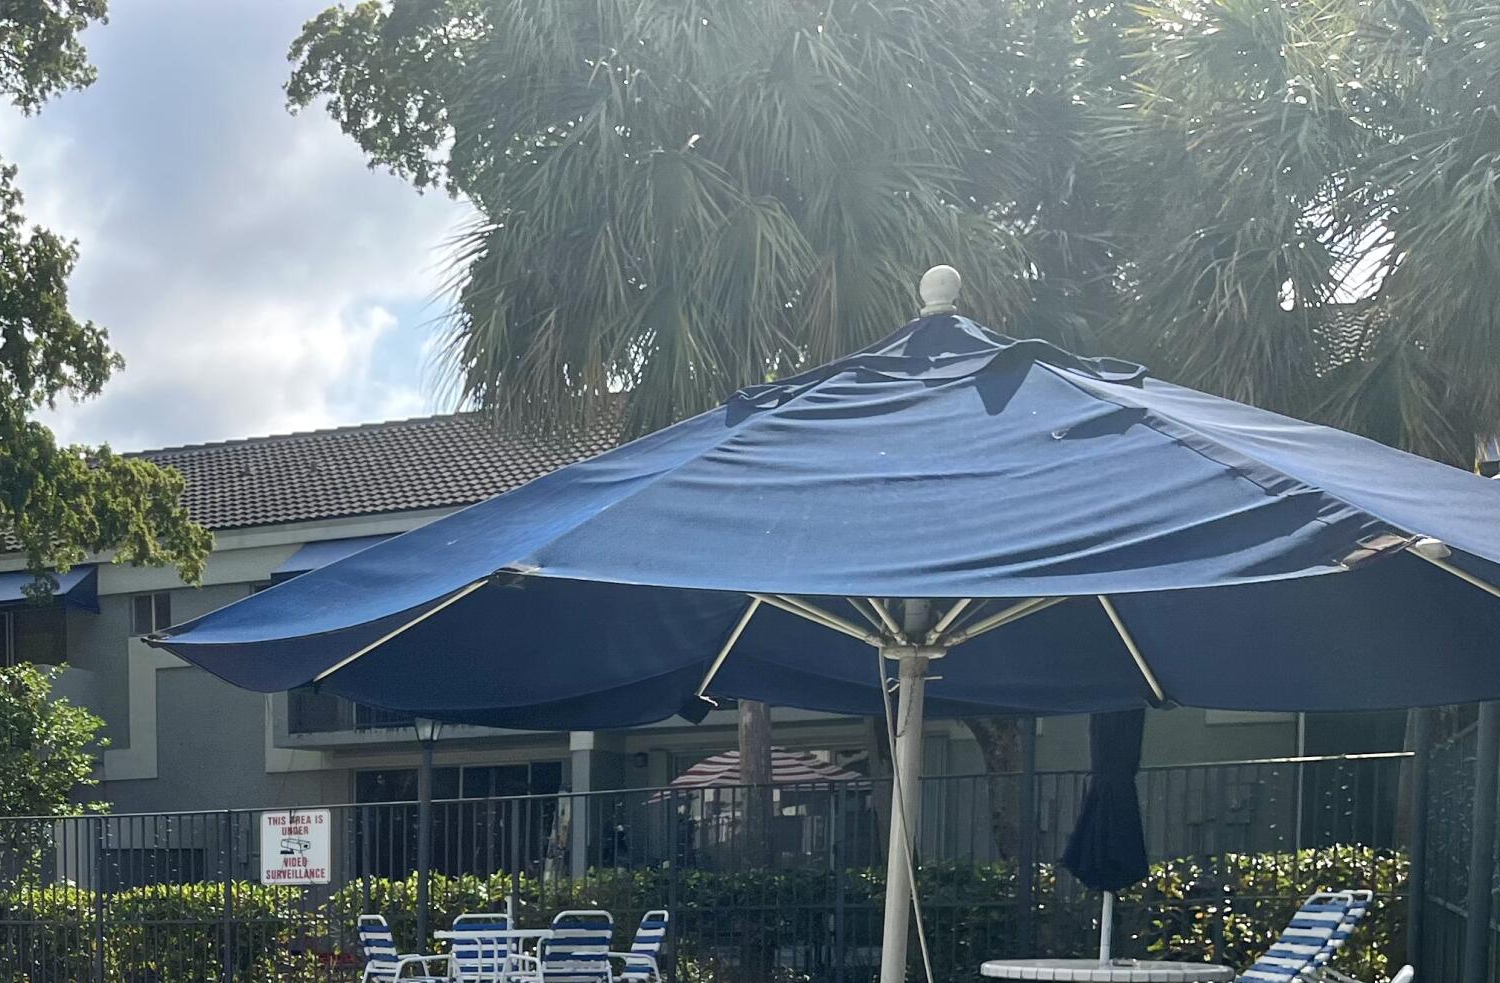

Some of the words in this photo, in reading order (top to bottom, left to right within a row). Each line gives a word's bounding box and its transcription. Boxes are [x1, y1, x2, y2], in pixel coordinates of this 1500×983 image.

[268, 816, 286, 826] THIS
[290, 815, 311, 825] AREA
[315, 814, 324, 824] IS
[281, 826, 309, 836] UNDER
[283, 857, 308, 867] VIDEO
[265, 868, 326, 880] SURVEILLANCE
